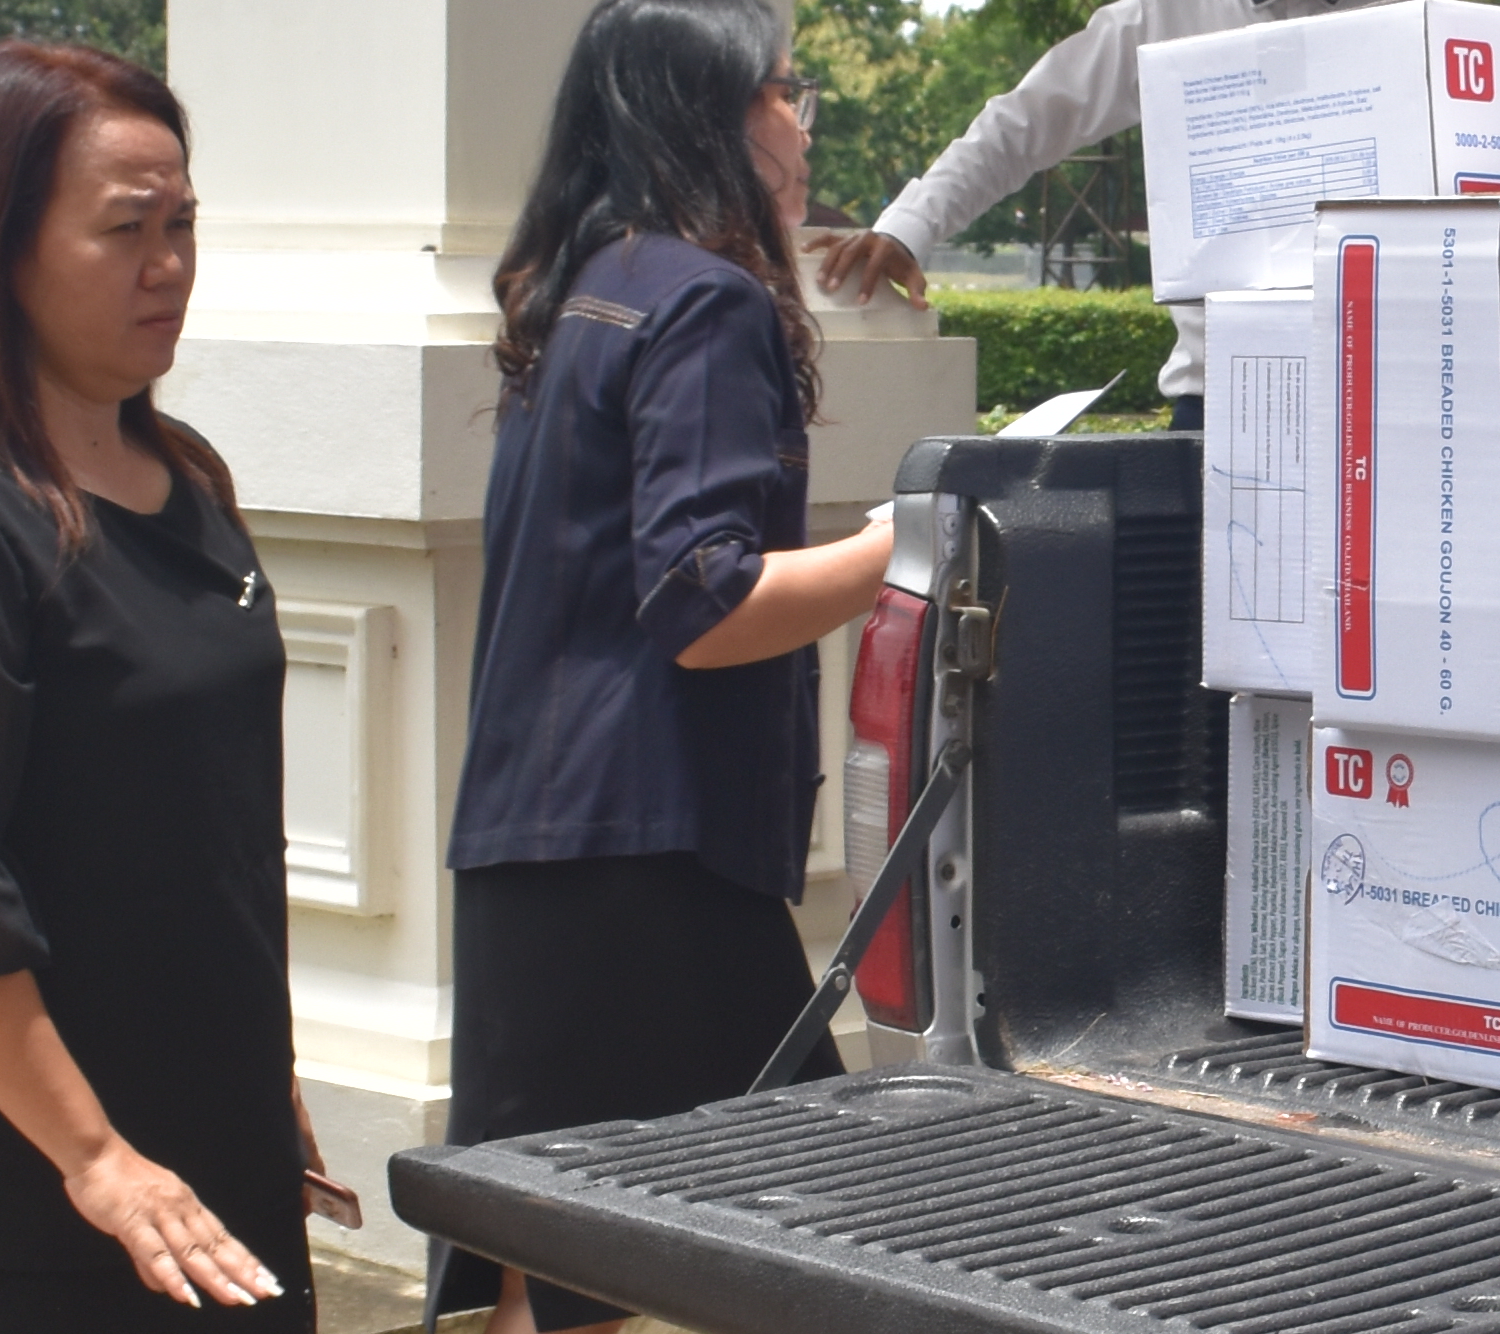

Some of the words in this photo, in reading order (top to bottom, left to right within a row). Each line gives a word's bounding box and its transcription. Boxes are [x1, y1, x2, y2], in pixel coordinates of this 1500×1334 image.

[1454, 49, 1485, 94] TC
[1440, 227, 1456, 337] 5301-1-5031
[1346, 300, 1354, 331] NAME
[1346, 335, 1354, 349] OF
[1440, 344, 1454, 440] BREADED
[1356, 456, 1367, 481] TC
[1440, 445, 1453, 534] CHICKEN
[1344, 483, 1352, 531] BUSINESS
[1439, 539, 1453, 624] GOUJON
[1440, 630, 1452, 651] 40
[1440, 669, 1452, 690] 60
[1440, 696, 1452, 715] G.
[1334, 763, 1364, 793] TC
[1372, 1015, 1394, 1027] NAME
[1396, 1019, 1406, 1028] OF
